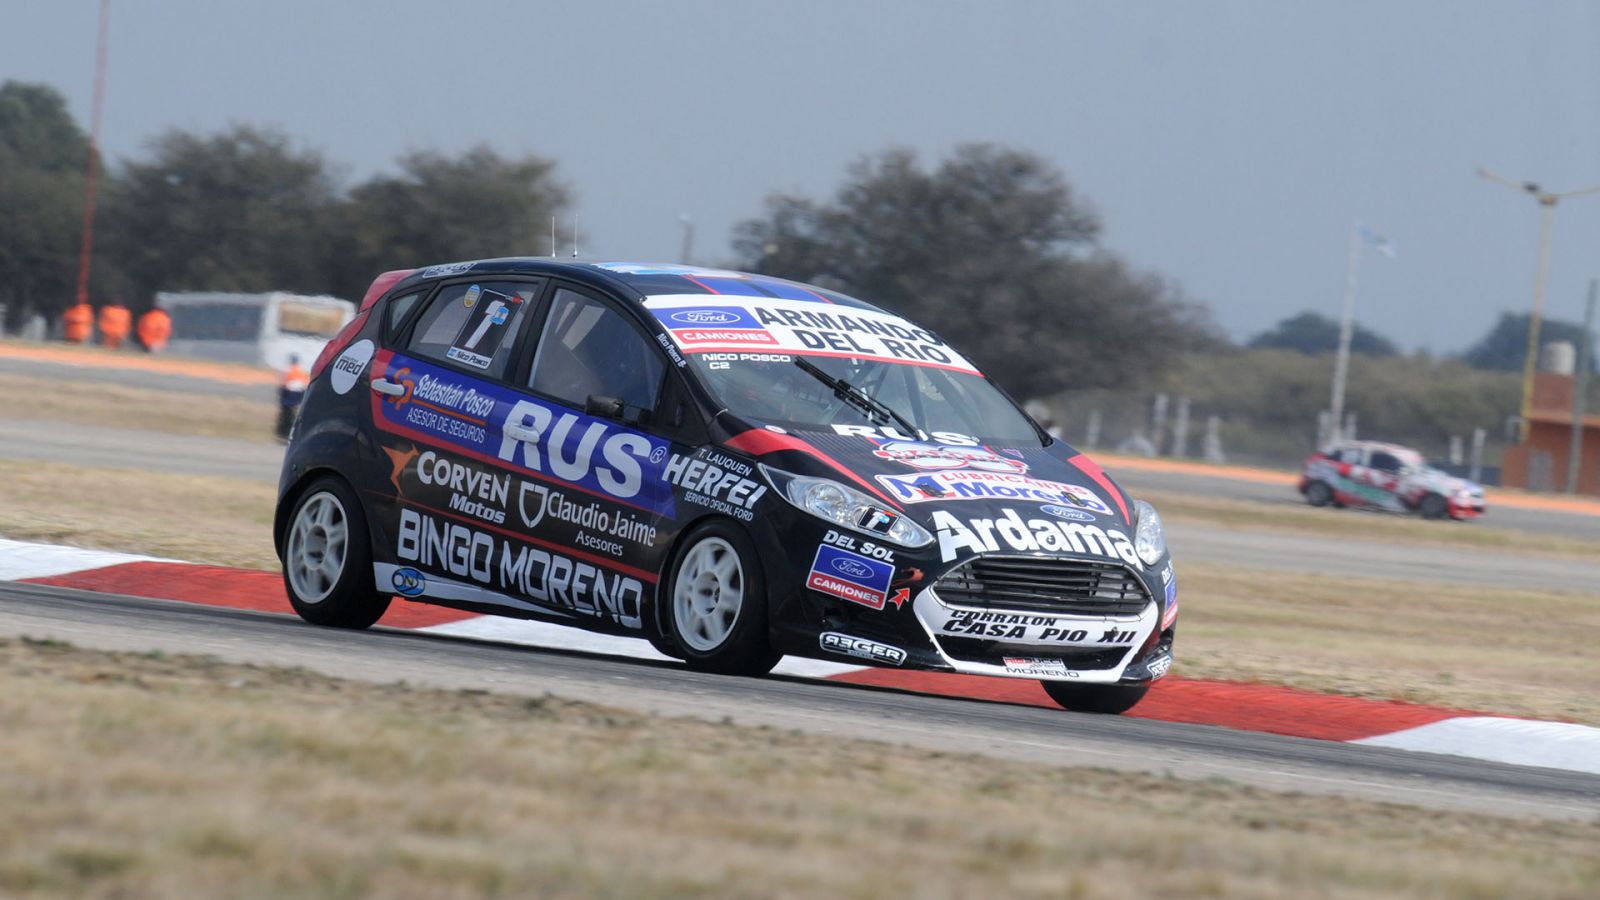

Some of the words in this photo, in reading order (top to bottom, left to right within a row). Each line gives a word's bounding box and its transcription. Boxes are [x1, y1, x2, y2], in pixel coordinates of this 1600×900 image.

[686, 311, 728, 322] Ford
[754, 306, 946, 347] ARMANDO
[682, 332, 769, 342] CAMIONES
[791, 329, 876, 354] DEL
[878, 337, 951, 364] RIO
[336, 358, 365, 376] med
[701, 353, 738, 362] NICO
[739, 354, 791, 363] POSCO
[708, 361, 730, 370] C2
[413, 374, 463, 408] Sebastián
[459, 388, 495, 417] Posco
[406, 407, 439, 430] ASESOR
[436, 416, 450, 433] DE
[448, 419, 487, 444] SEGUROS
[831, 423, 980, 446] RUS
[498, 399, 651, 498] RUS
[699, 448, 708, 459] T.
[706, 451, 753, 476] LAUQUEN
[417, 451, 510, 509] CORVEN
[449, 492, 506, 524] Motos
[547, 491, 609, 532] Claudio
[609, 510, 656, 547] Jaime
[684, 491, 710, 508] SERVICIO
[709, 497, 733, 516] OFICIAL
[732, 508, 754, 522] FORD
[575, 530, 624, 557] Asesores
[823, 530, 856, 550] DEL
[860, 542, 895, 562] SOL
[932, 508, 1143, 571] Ardama
[397, 508, 495, 583] BINGO
[500, 541, 643, 629] MORENO
[838, 560, 867, 576] Ford
[813, 577, 879, 604] CAMIONES
[942, 619, 1027, 639] CASA
[1039, 628, 1089, 642] PIO
[1095, 628, 1137, 643] XII
[951, 609, 1057, 627] CORRALON
